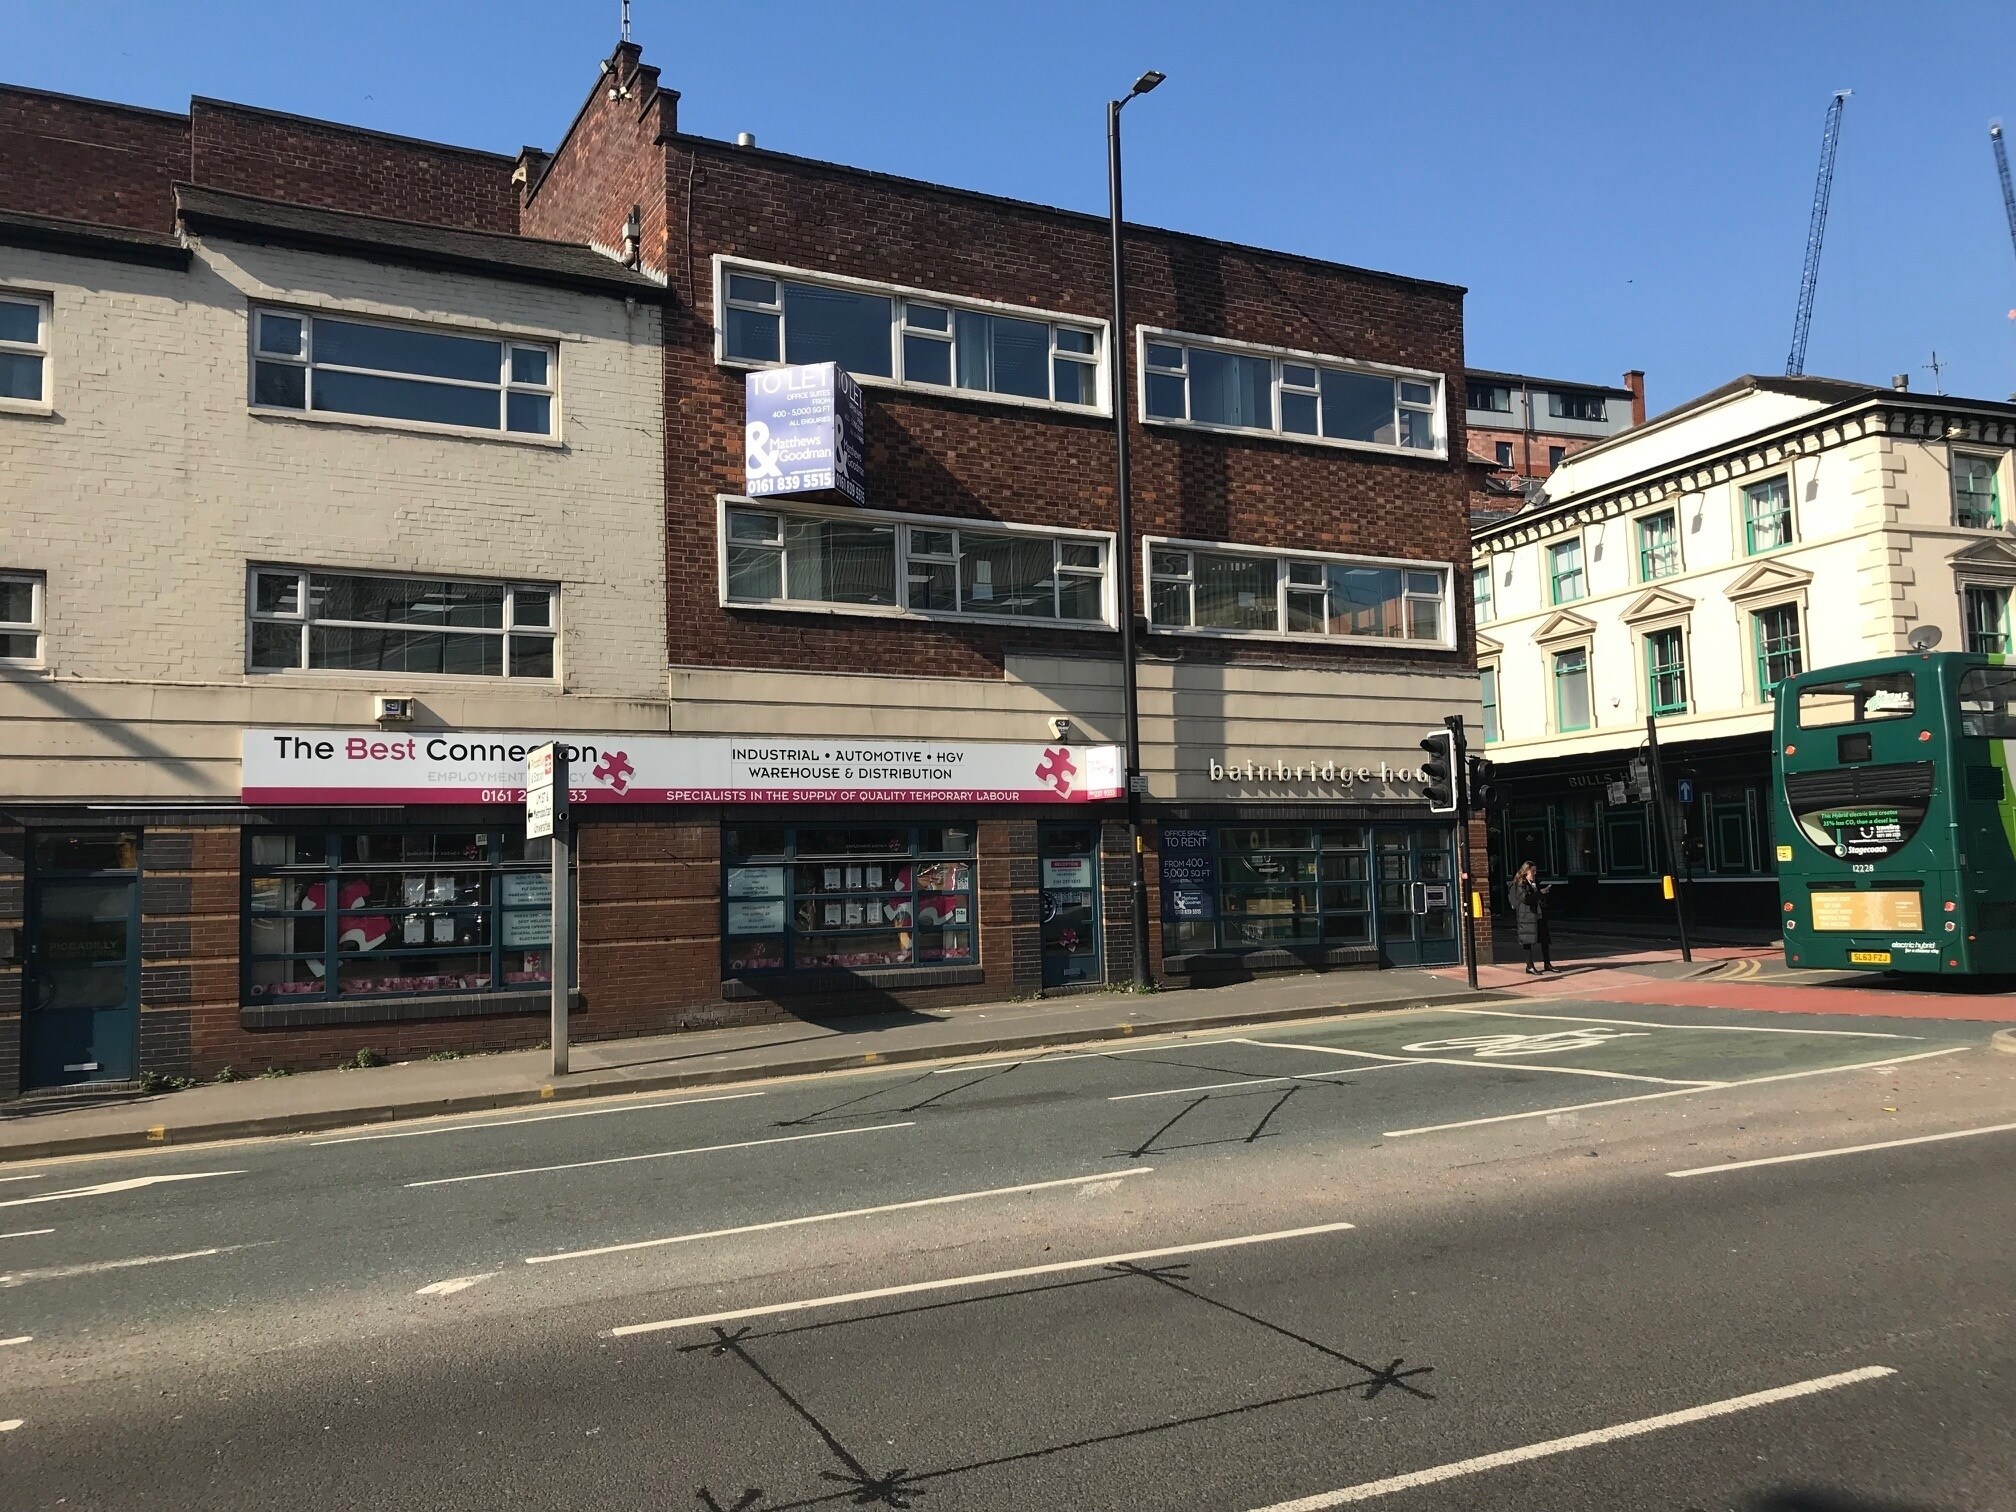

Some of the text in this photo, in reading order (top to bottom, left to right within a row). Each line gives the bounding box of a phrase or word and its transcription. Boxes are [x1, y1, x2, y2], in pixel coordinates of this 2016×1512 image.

[749, 364, 832, 395] TO LET
[836, 366, 863, 409] TO LET
[786, 389, 831, 400] OFFICE SUITES
[812, 397, 831, 406] FROM
[772, 409, 787, 418] 400
[791, 407, 812, 416] 5,000
[789, 419, 800, 427] ALL
[769, 435, 822, 451] Matthews
[779, 448, 832, 462] Goodman
[747, 478, 774, 494] 0161
[777, 475, 800, 491] 839
[803, 471, 832, 488] 5515
[273, 736, 334, 760] The
[345, 737, 416, 761] Best
[732, 749, 964, 763] INDUSTRIAL AUTOMOTIVE HGV
[427, 771, 525, 782] EMPLOYMENT
[748, 767, 952, 779] WAREHOUSE & DISTRIBUTION
[1209, 758, 1429, 788] bainbridge hou
[1568, 773, 1613, 787] BULLS
[481, 789, 512, 802] 0161
[666, 790, 1020, 801] SPECIALISTS IN THE SUPPLY OF QUALITY TEMPORARY LABOUR
[1187, 829, 1207, 837] SPACE
[1165, 837, 1207, 847] TO RENT
[1848, 845, 1888, 856] Stagecoach
[1164, 860, 1185, 868] FROM
[1185, 858, 1204, 868] 400
[1852, 864, 1874, 873] 12228
[1163, 868, 1189, 879] 5,000
[1201, 869, 1211, 877] FT
[1854, 953, 1888, 962] SL63 FZJ
